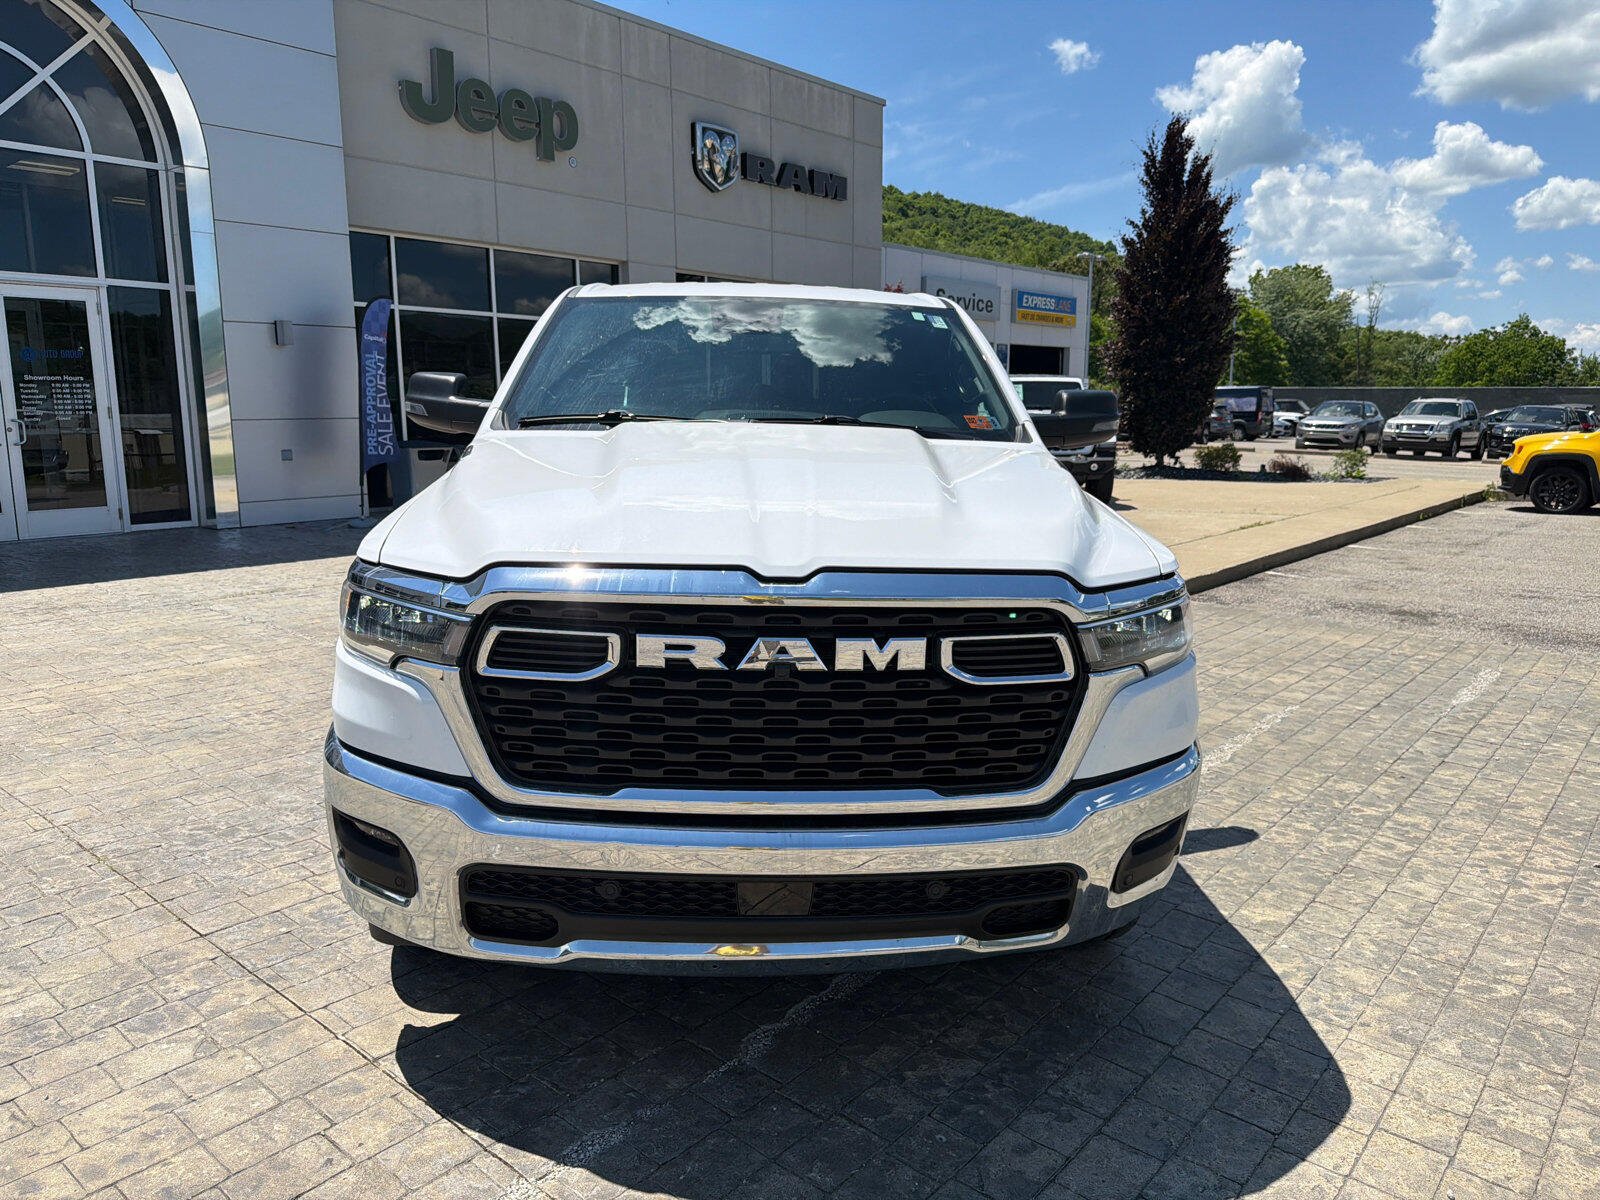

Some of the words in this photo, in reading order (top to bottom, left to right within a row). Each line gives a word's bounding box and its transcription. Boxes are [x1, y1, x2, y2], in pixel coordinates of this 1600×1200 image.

[399, 47, 579, 162] Jeep
[740, 152, 848, 201] RAM
[365, 350, 378, 455] PRE-APPROVAL
[375, 350, 391, 407] EVENT
[377, 413, 394, 455] SALE
[635, 633, 929, 672] RAM
